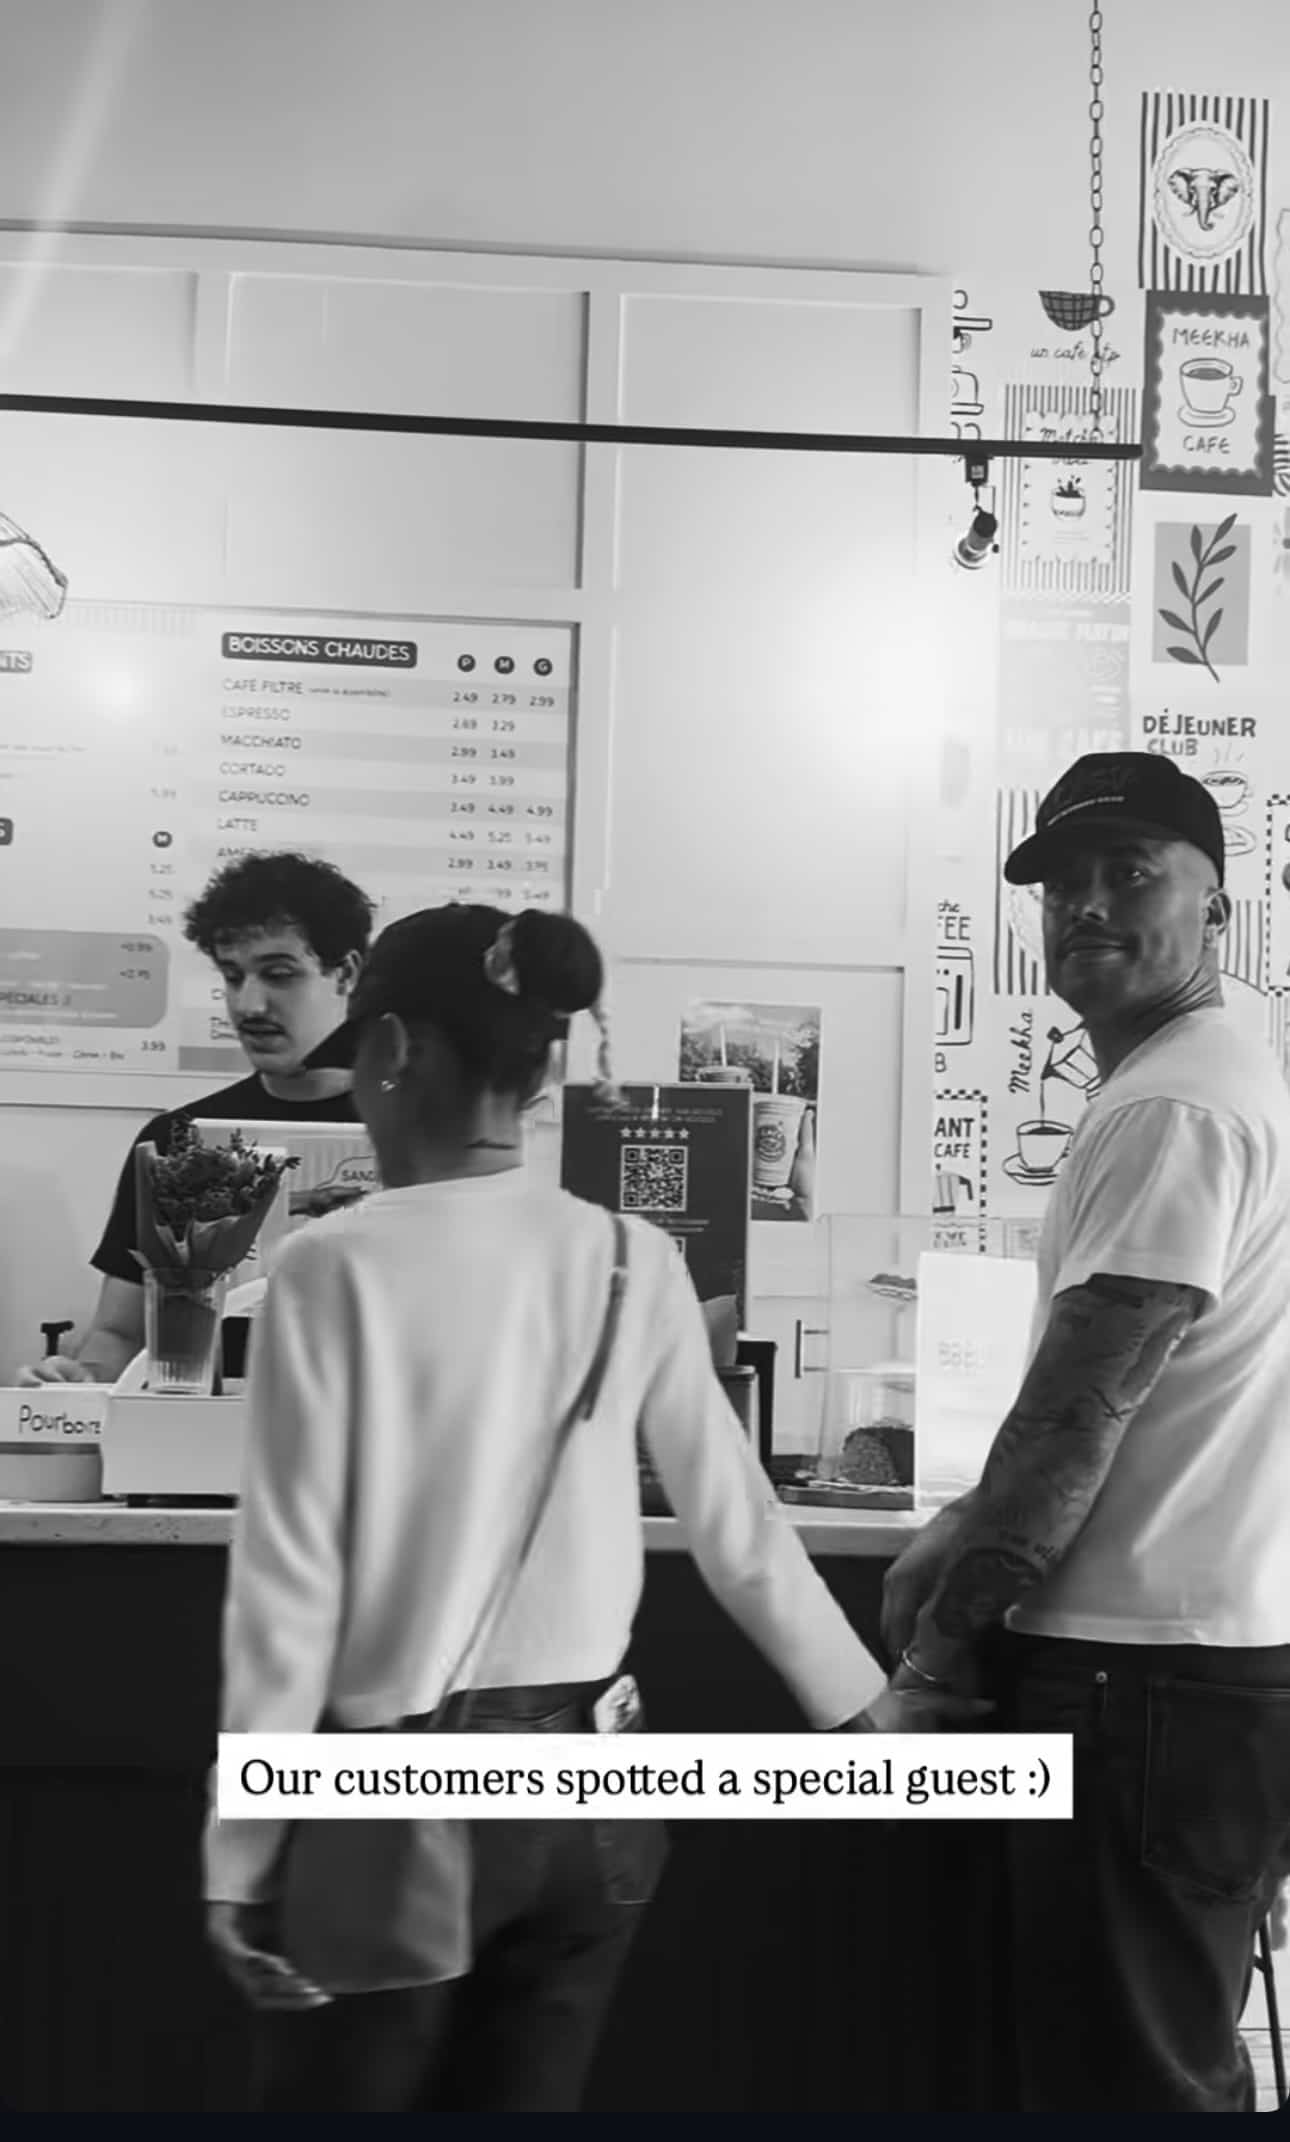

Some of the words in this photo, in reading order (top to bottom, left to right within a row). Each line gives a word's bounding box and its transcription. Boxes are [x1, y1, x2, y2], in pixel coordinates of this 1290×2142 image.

[1171, 328, 1250, 348] MEEKHA
[1183, 435, 1230, 454] CAFE
[229, 636, 319, 657] BOISSONS
[324, 641, 411, 661] CHAUDES
[262, 681, 304, 695] FILTRE
[222, 706, 292, 721] ESPRESSO
[1143, 708, 1257, 738] DÉJEUNER
[220, 735, 302, 750] MACCHIATO
[1147, 738, 1198, 756] CLUB
[219, 762, 287, 777] CORTADO
[218, 789, 311, 807] CAPPUCCINO
[216, 818, 258, 832] LATTE
[937, 916, 971, 941] EE
[1007, 1010, 1033, 1095] Meekha
[934, 1117, 976, 1138] ANT
